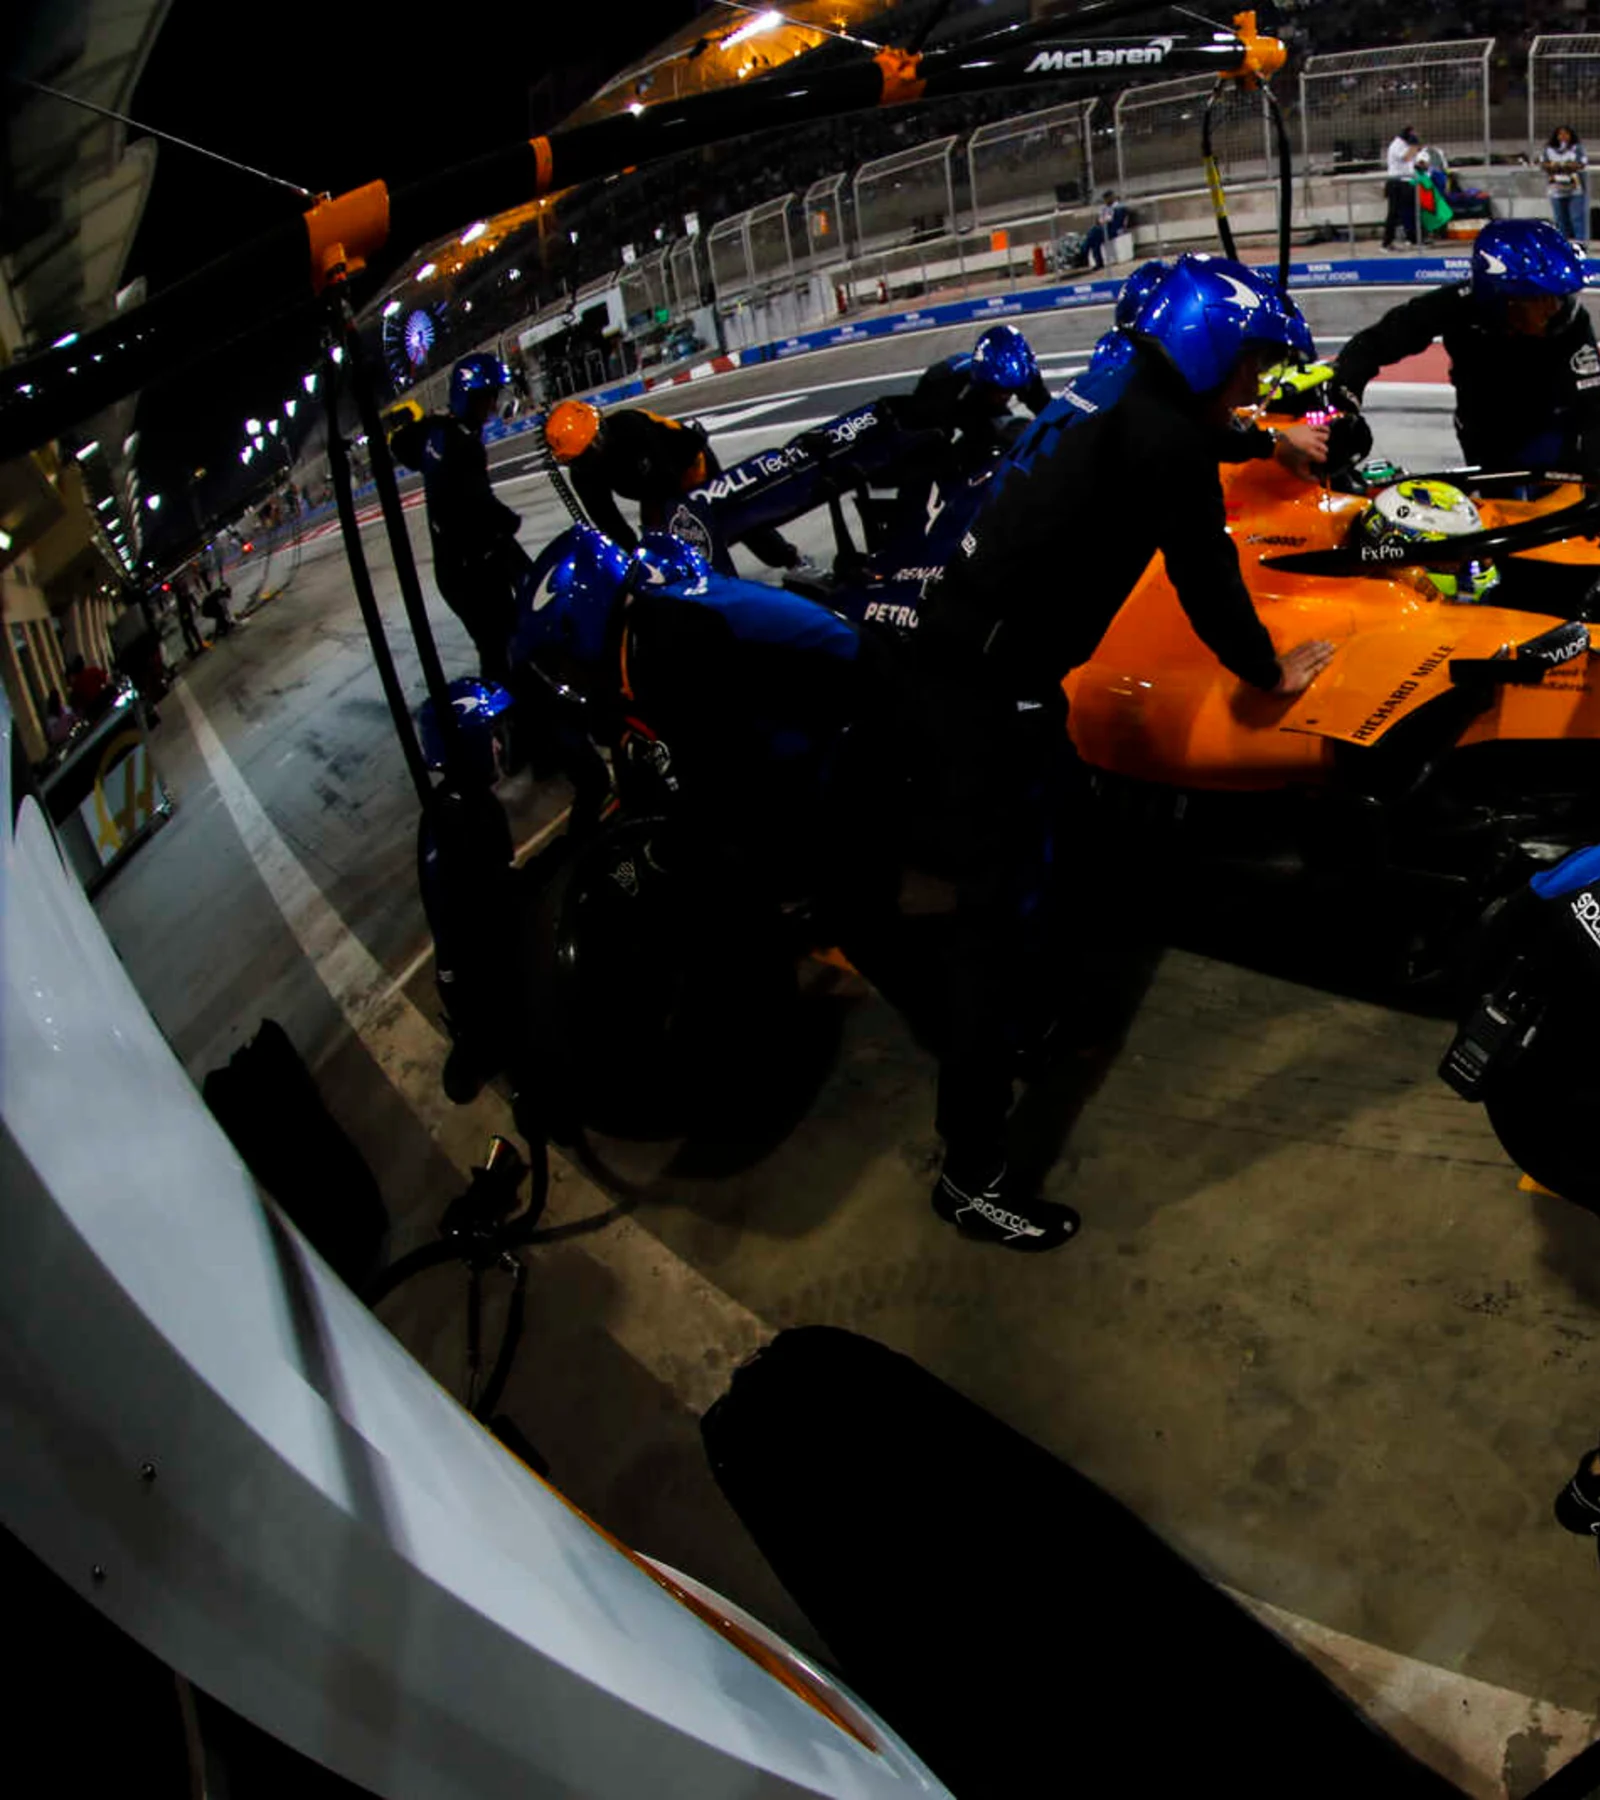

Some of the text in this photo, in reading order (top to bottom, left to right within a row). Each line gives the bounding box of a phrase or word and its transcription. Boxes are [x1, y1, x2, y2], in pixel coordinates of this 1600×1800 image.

[1023, 47, 1162, 74] McLaren
[688, 472, 759, 505] DELL
[1360, 543, 1406, 563] FxPro
[1352, 643, 1457, 742] RICHARD MILLE
[968, 1197, 1033, 1233] sparco
